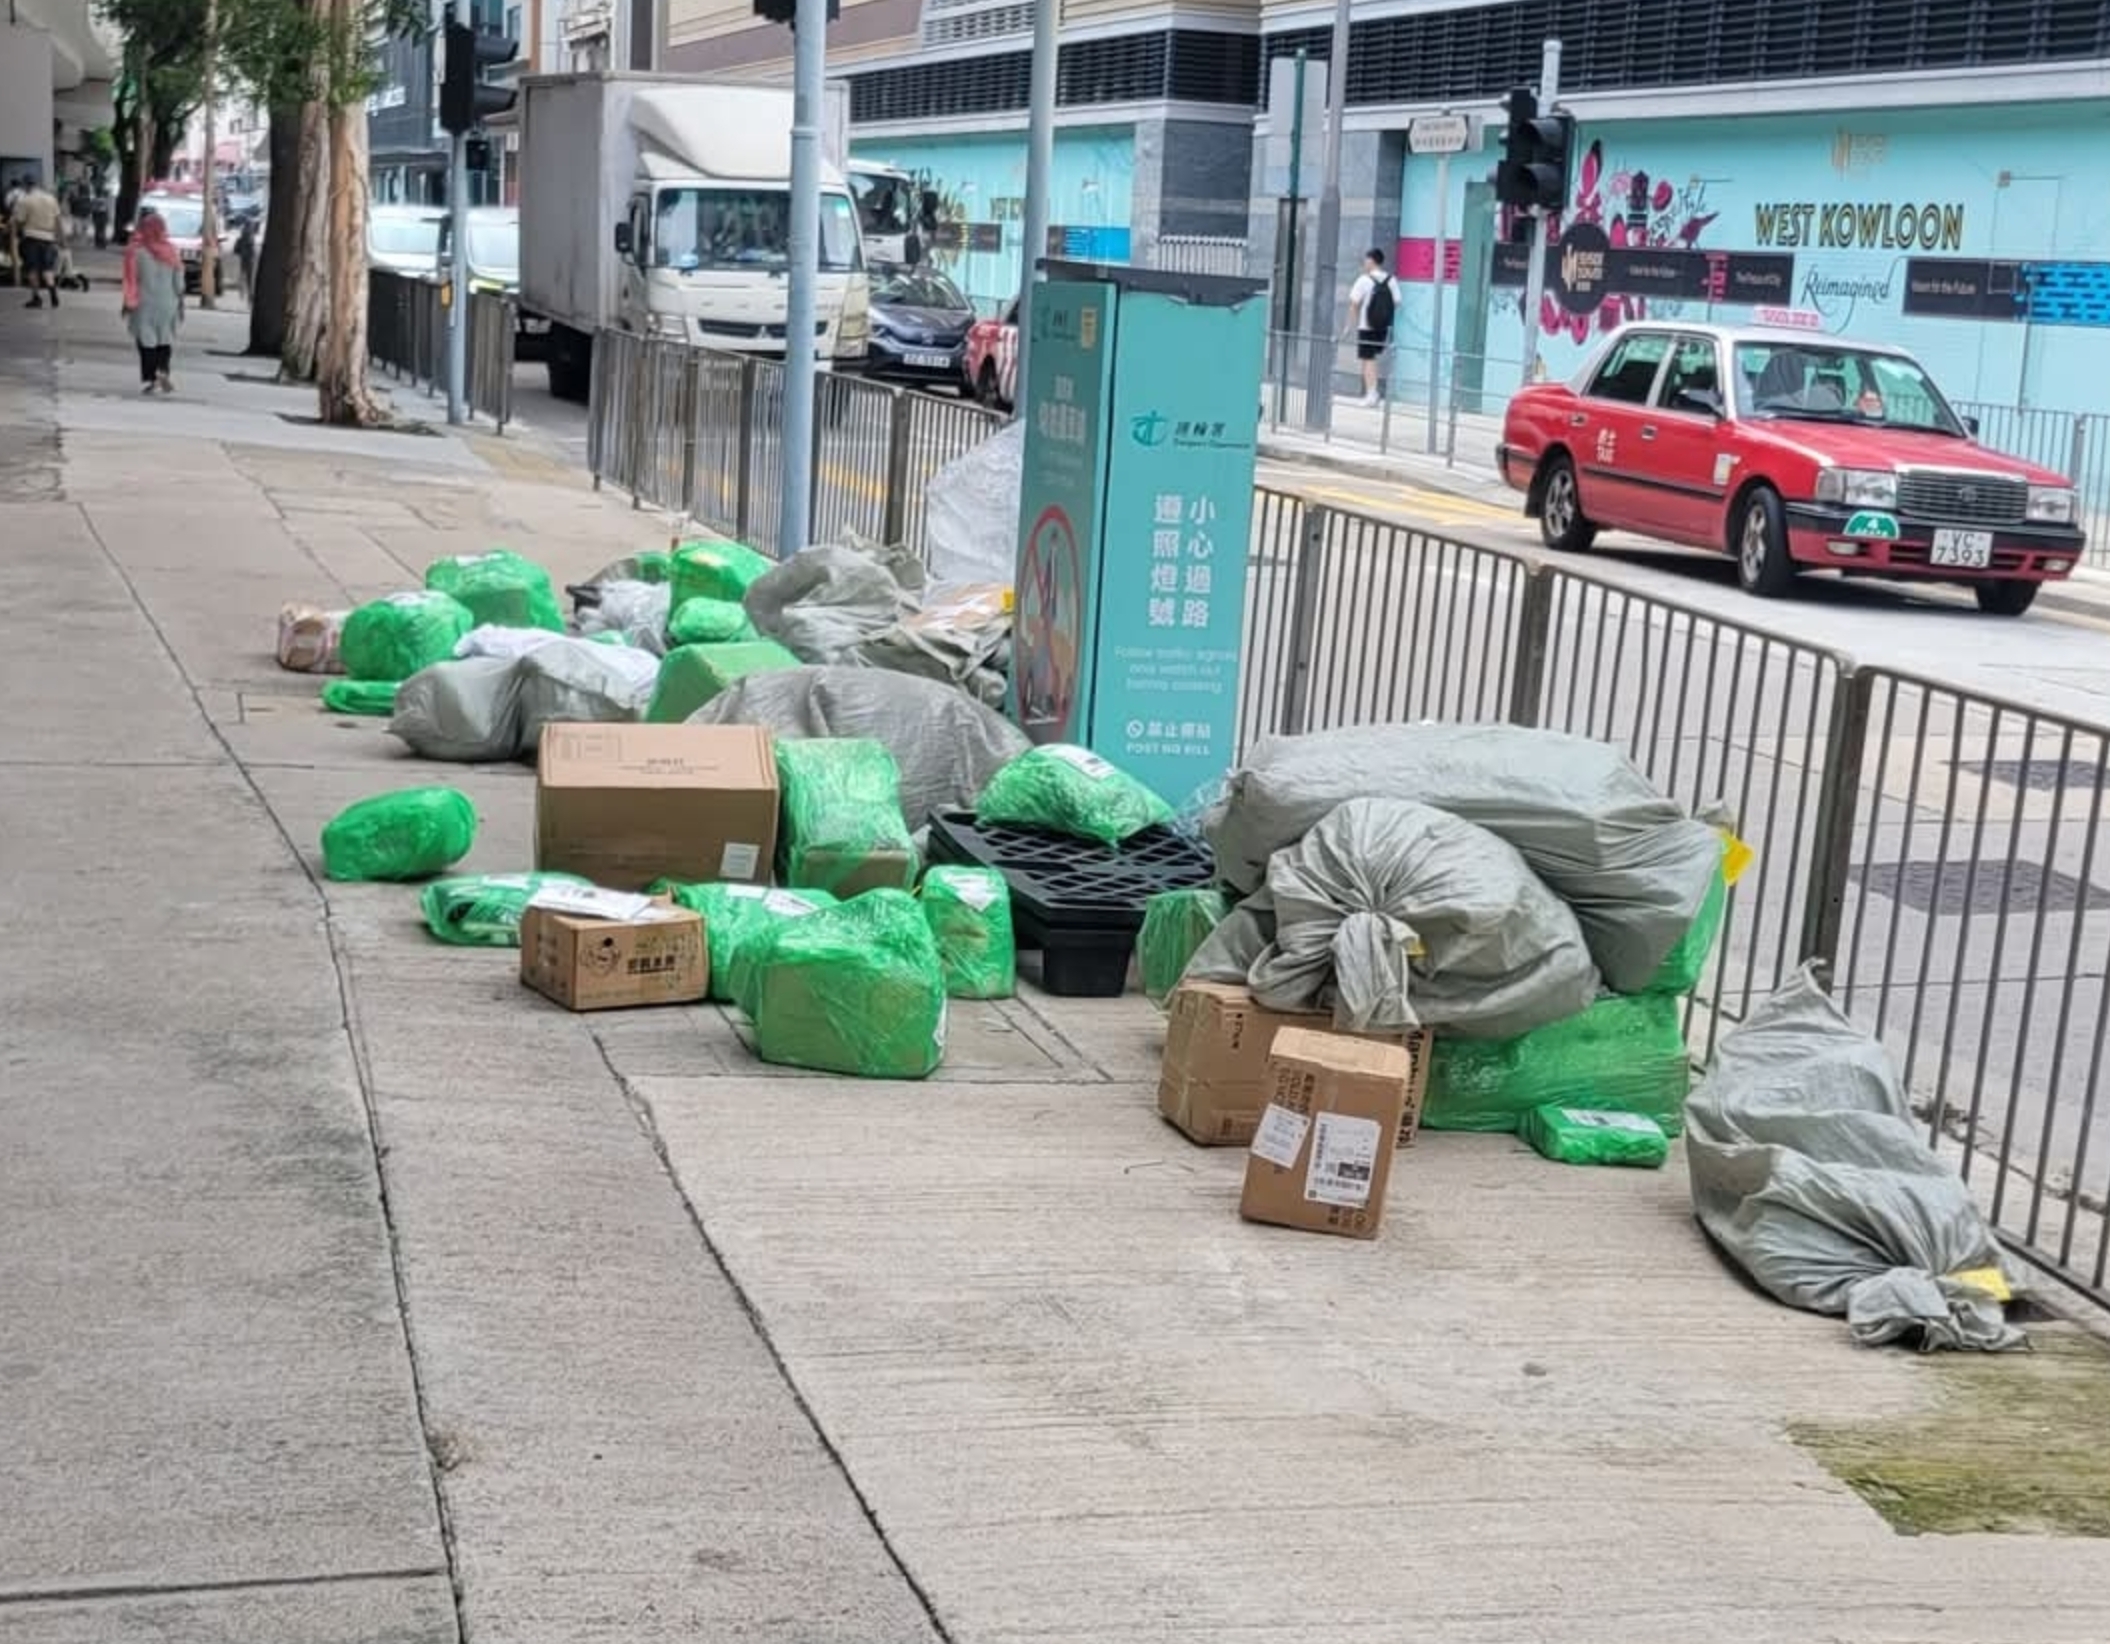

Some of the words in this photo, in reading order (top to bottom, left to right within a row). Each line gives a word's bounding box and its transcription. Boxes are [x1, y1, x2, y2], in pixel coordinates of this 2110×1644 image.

[1755, 203, 1815, 247] WEST
[1818, 203, 1964, 250] KOWLOON
[1801, 256, 1902, 326] Reimagined
[1182, 495, 1215, 628] 小心過路
[1937, 547, 1986, 567] 7393
[1126, 741, 1160, 755] POST
[1161, 743, 1181, 755] NO
